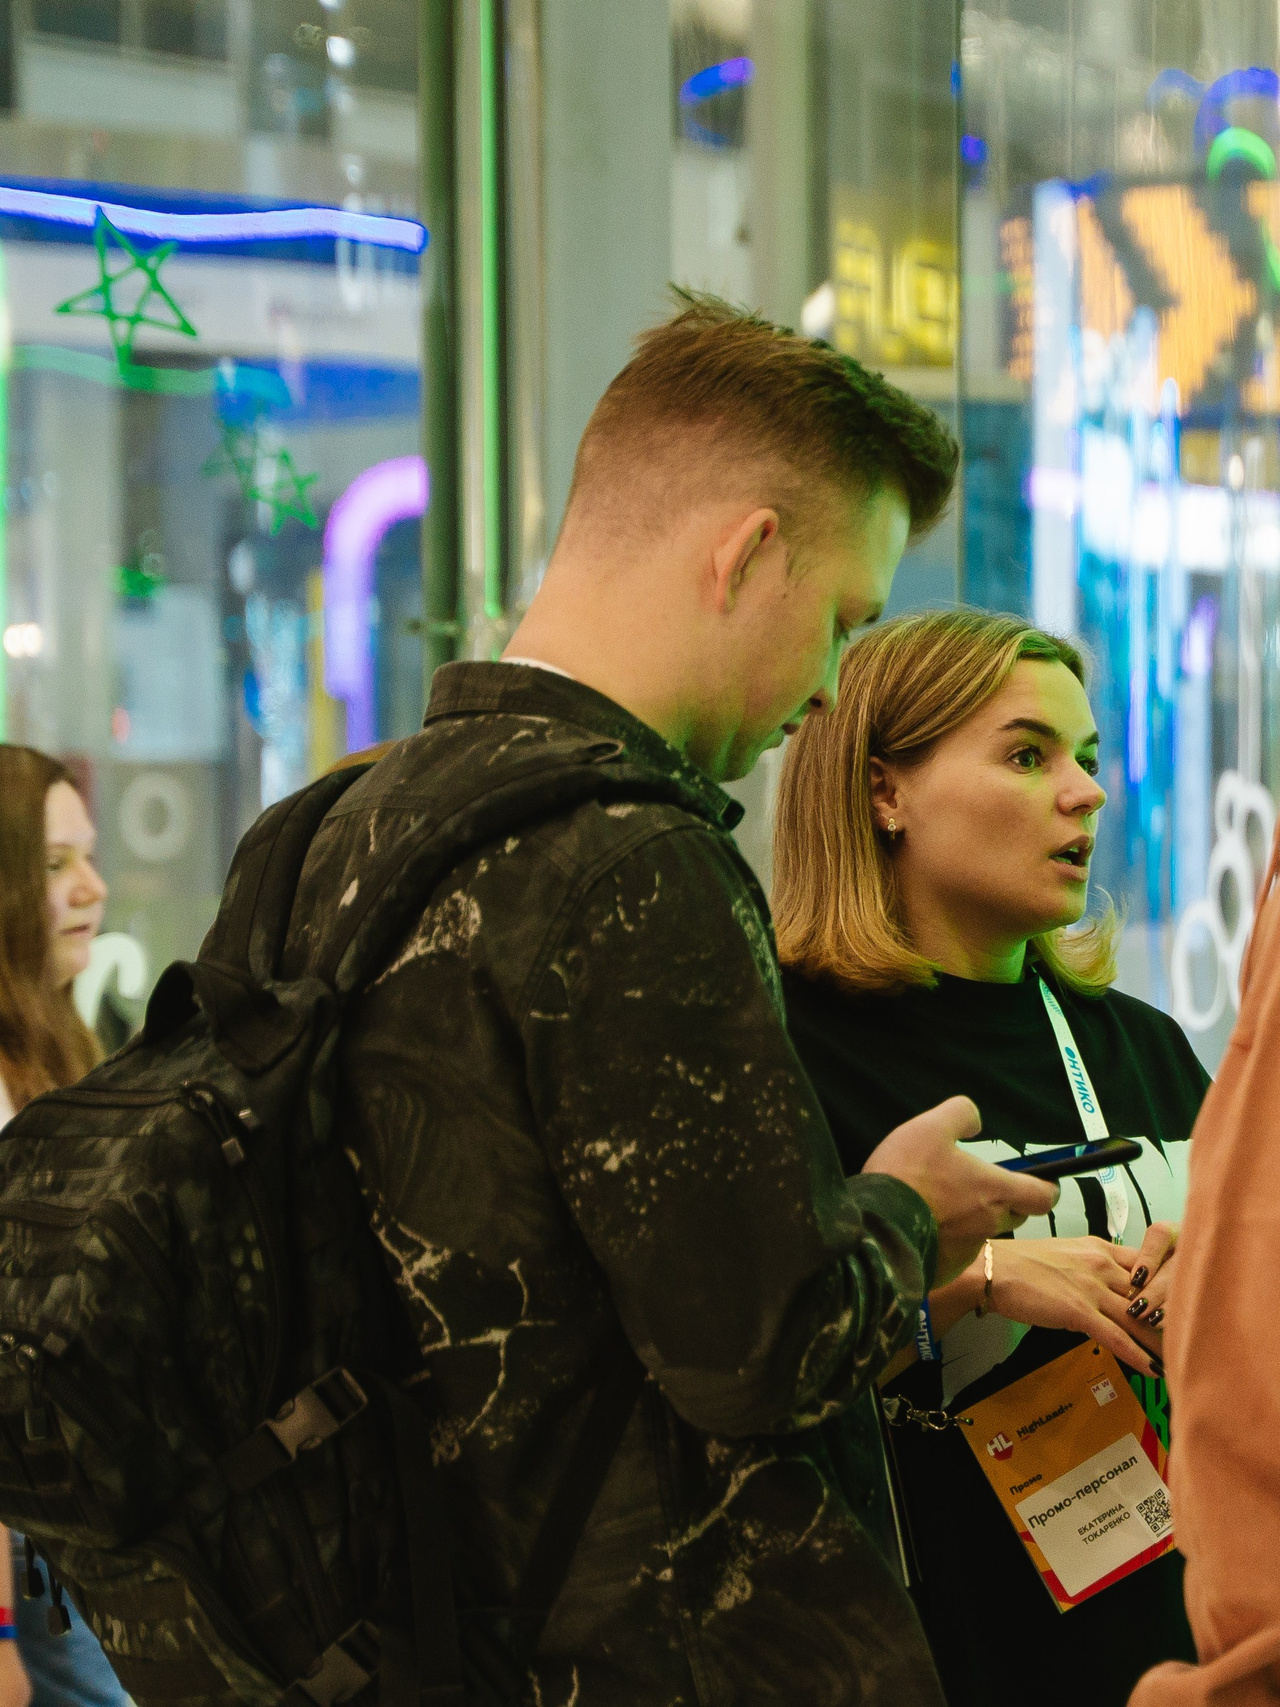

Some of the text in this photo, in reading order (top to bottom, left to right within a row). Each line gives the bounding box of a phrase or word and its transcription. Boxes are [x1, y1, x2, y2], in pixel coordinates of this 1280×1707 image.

[1064, 1046, 1095, 1114] ОНТИКО
[1016, 1402, 1073, 1438] HighLoad++
[1009, 1473, 1043, 1495] Промо
[1027, 1455, 1139, 1529] Промо-персонал
[1077, 1503, 1125, 1536] ЕКАТЕРИНА
[1082, 1511, 1131, 1545] ТОКАРЕНКО
